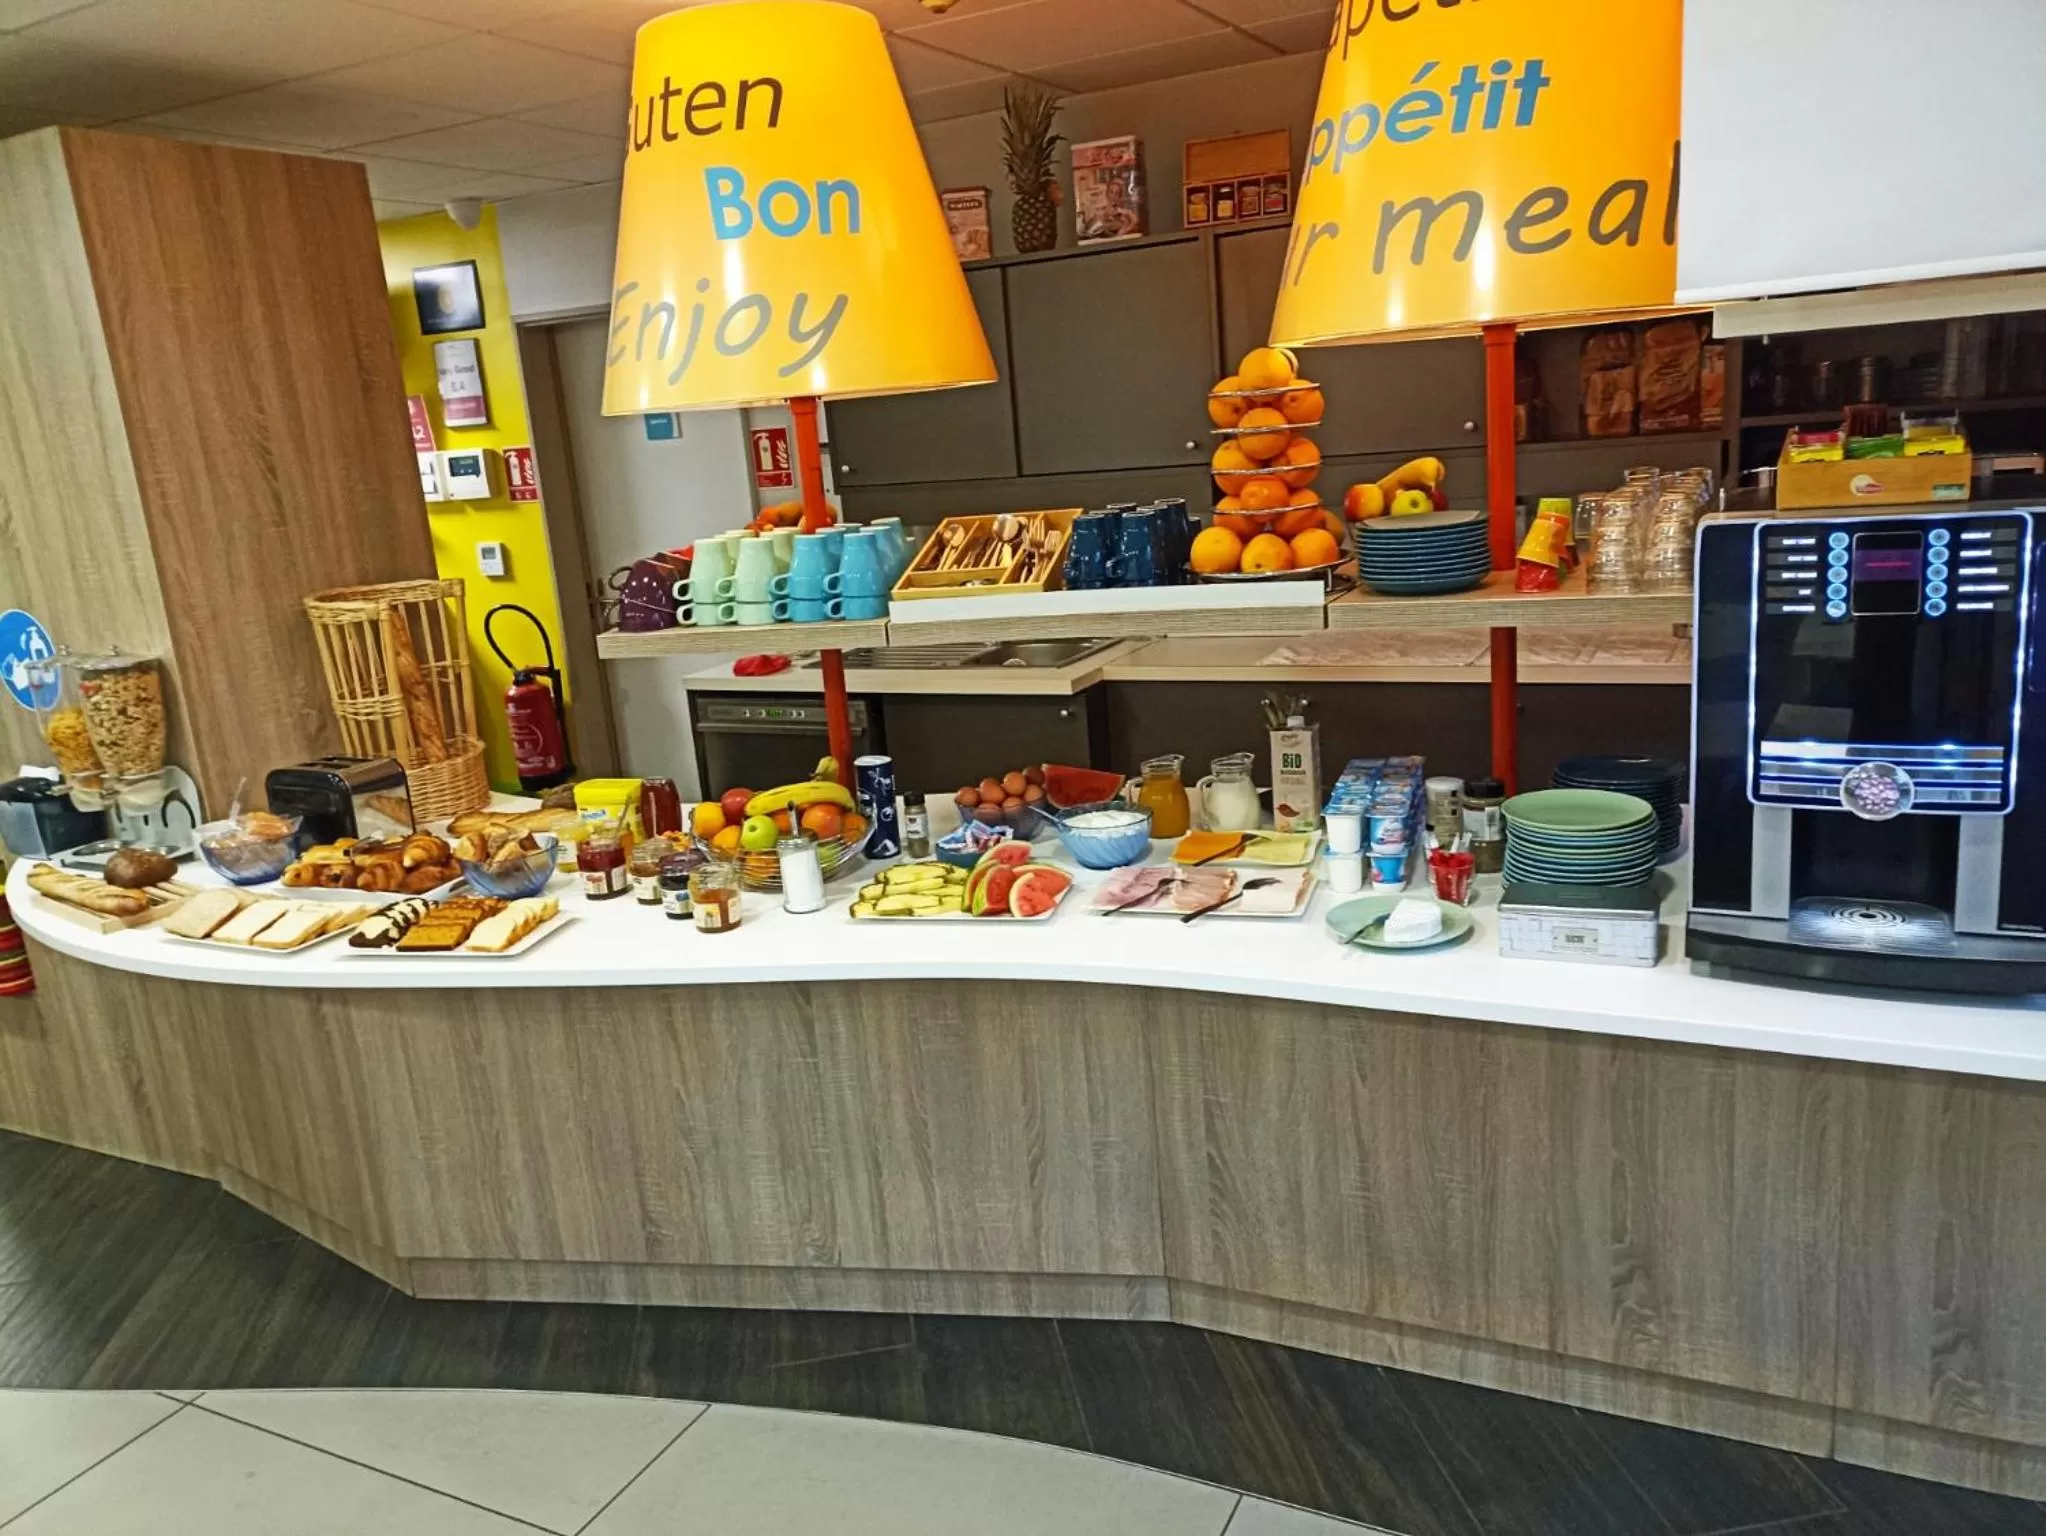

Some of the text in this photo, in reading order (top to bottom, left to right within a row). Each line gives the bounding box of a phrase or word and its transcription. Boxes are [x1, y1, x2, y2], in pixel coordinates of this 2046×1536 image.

[632, 76, 784, 152] uten
[1306, 59, 1550, 185] ppétit
[702, 166, 861, 240] Bon
[1373, 139, 1681, 275] meal
[609, 277, 849, 386] Enjoy
